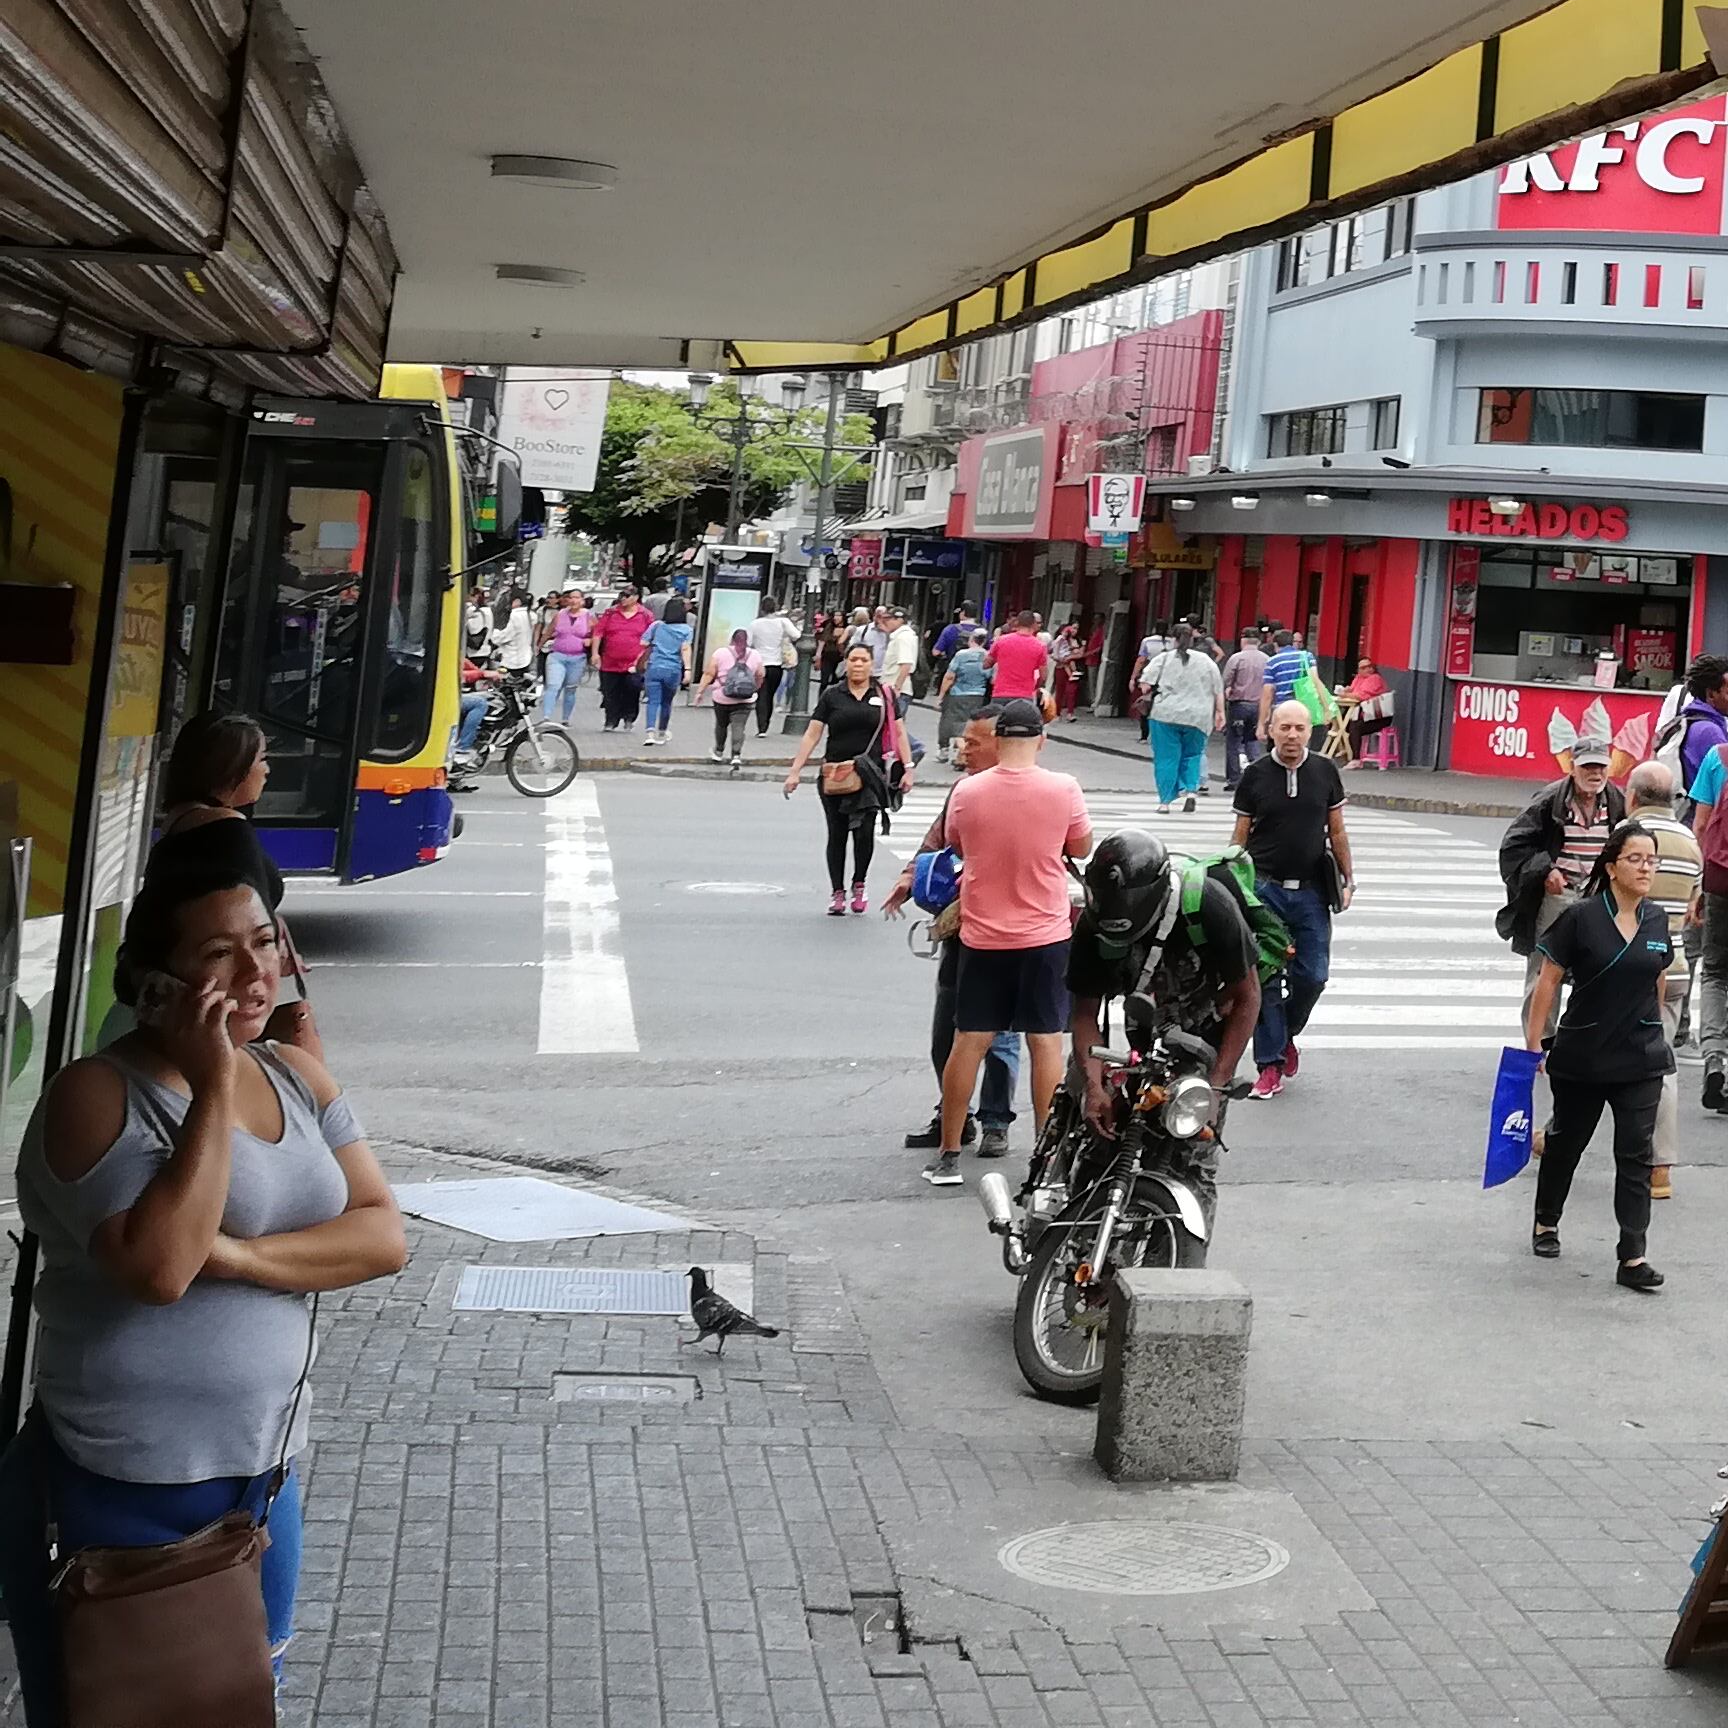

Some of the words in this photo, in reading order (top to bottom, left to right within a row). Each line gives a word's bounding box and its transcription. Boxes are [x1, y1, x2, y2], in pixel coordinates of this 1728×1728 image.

[513, 437, 585, 455] BooStore
[1447, 497, 1630, 543] HELADOS
[1459, 685, 1520, 723] CONOS
